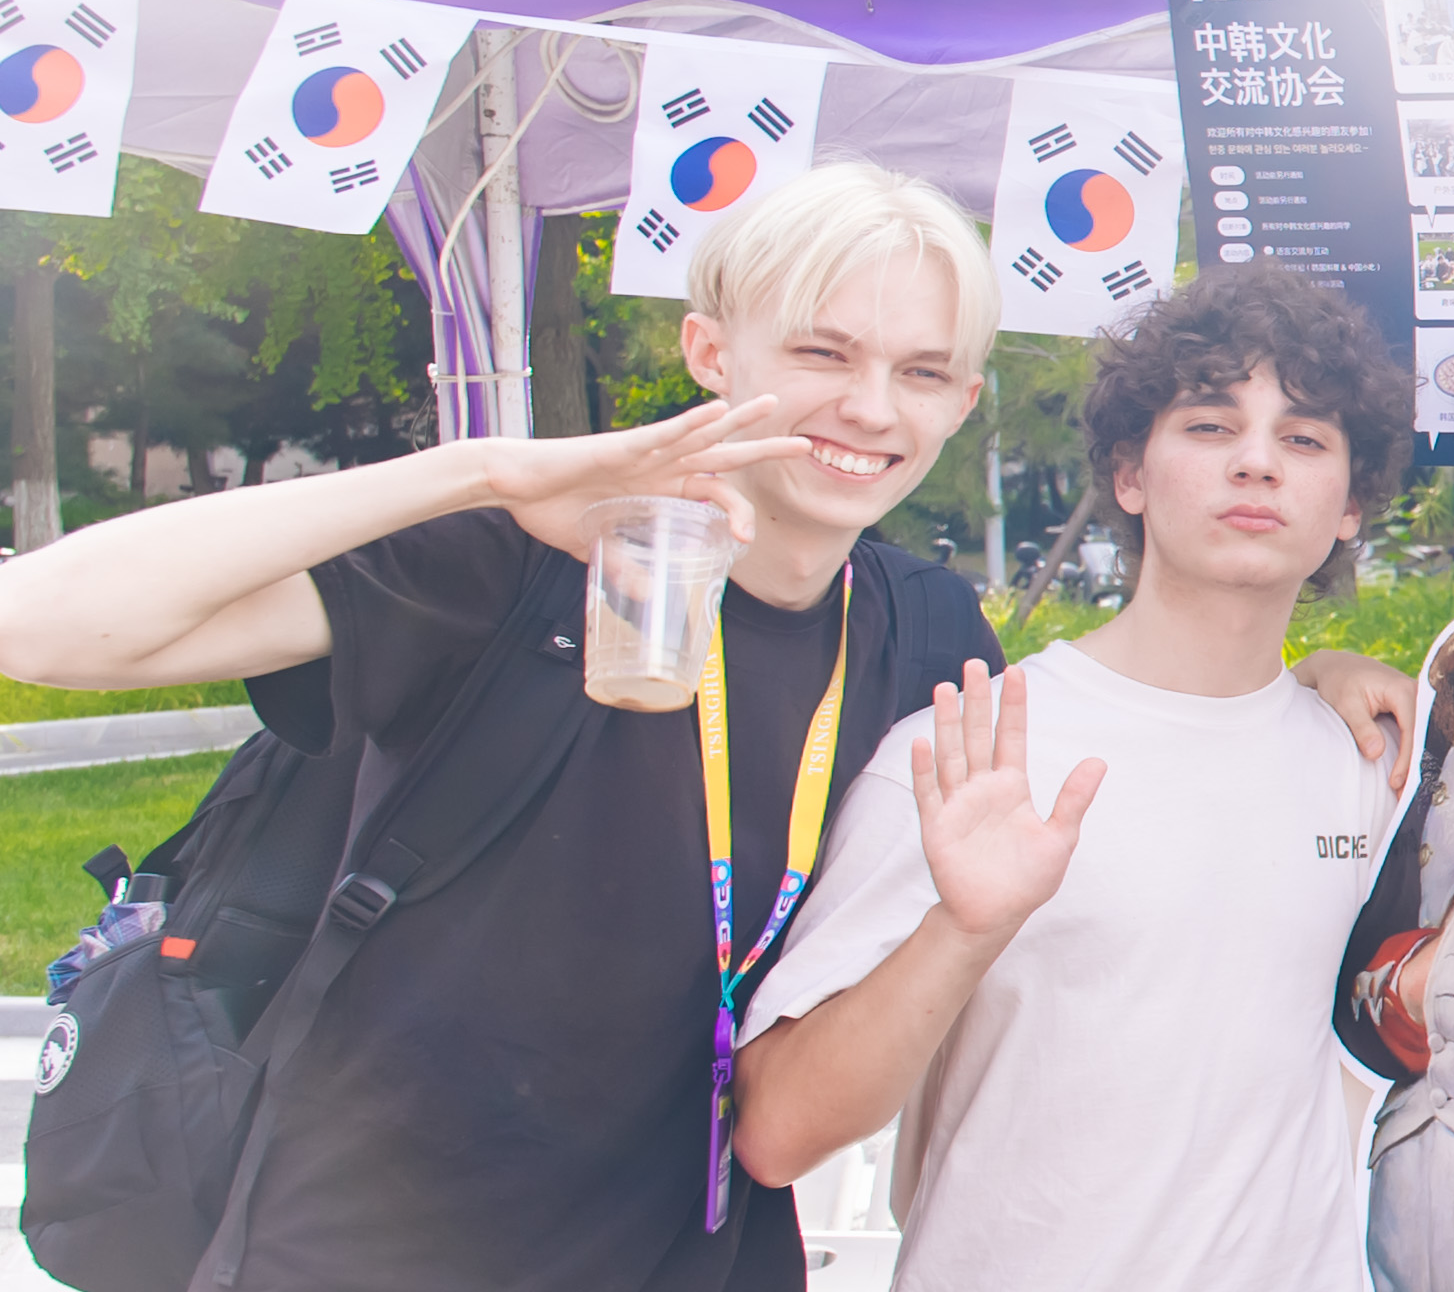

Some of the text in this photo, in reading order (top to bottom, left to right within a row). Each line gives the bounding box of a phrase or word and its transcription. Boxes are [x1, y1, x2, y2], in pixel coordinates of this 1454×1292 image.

[1194, 21, 1336, 63] 中韩文化
[1200, 65, 1346, 107] 交流协会
